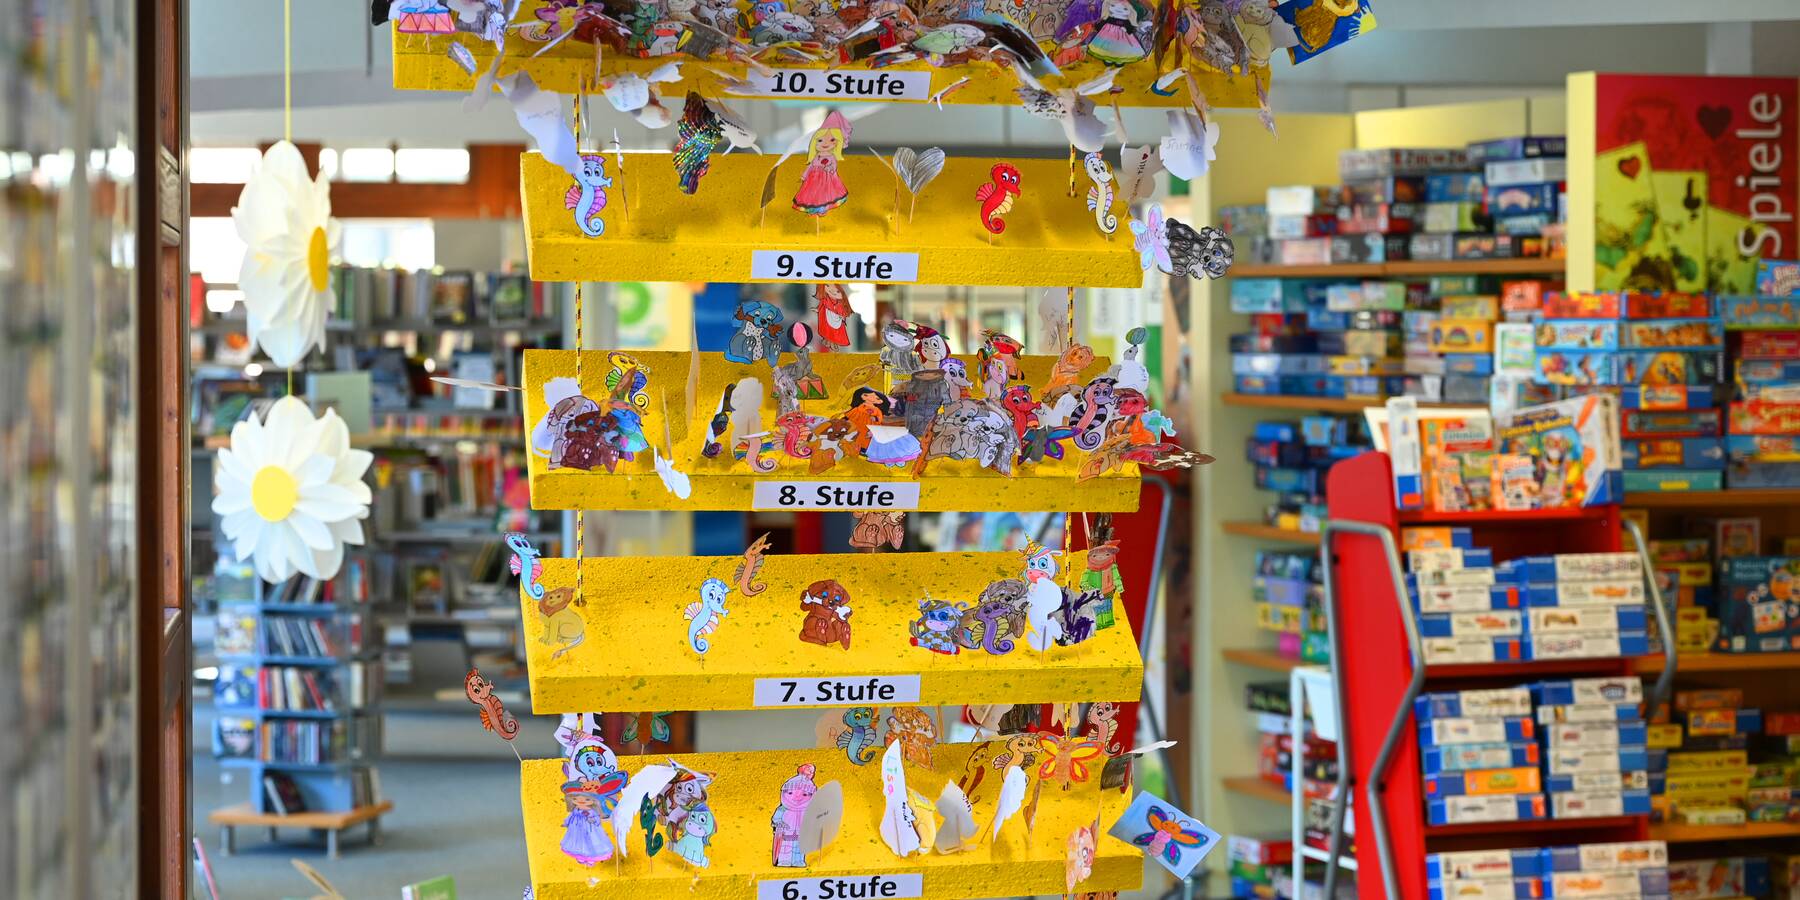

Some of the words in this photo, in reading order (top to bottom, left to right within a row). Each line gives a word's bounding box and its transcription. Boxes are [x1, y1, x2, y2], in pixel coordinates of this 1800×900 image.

[771, 72, 815, 93] 10.
[825, 73, 905, 95] Stufe
[1735, 92, 1793, 257] Spiele
[776, 254, 803, 278] 9.
[813, 255, 893, 279] Stufe
[778, 485, 805, 506] 8.
[815, 485, 895, 506] Stufe
[780, 681, 806, 703] 7.
[816, 678, 895, 701] Stufe
[782, 880, 808, 900] 6.
[818, 876, 897, 899] Stufe
